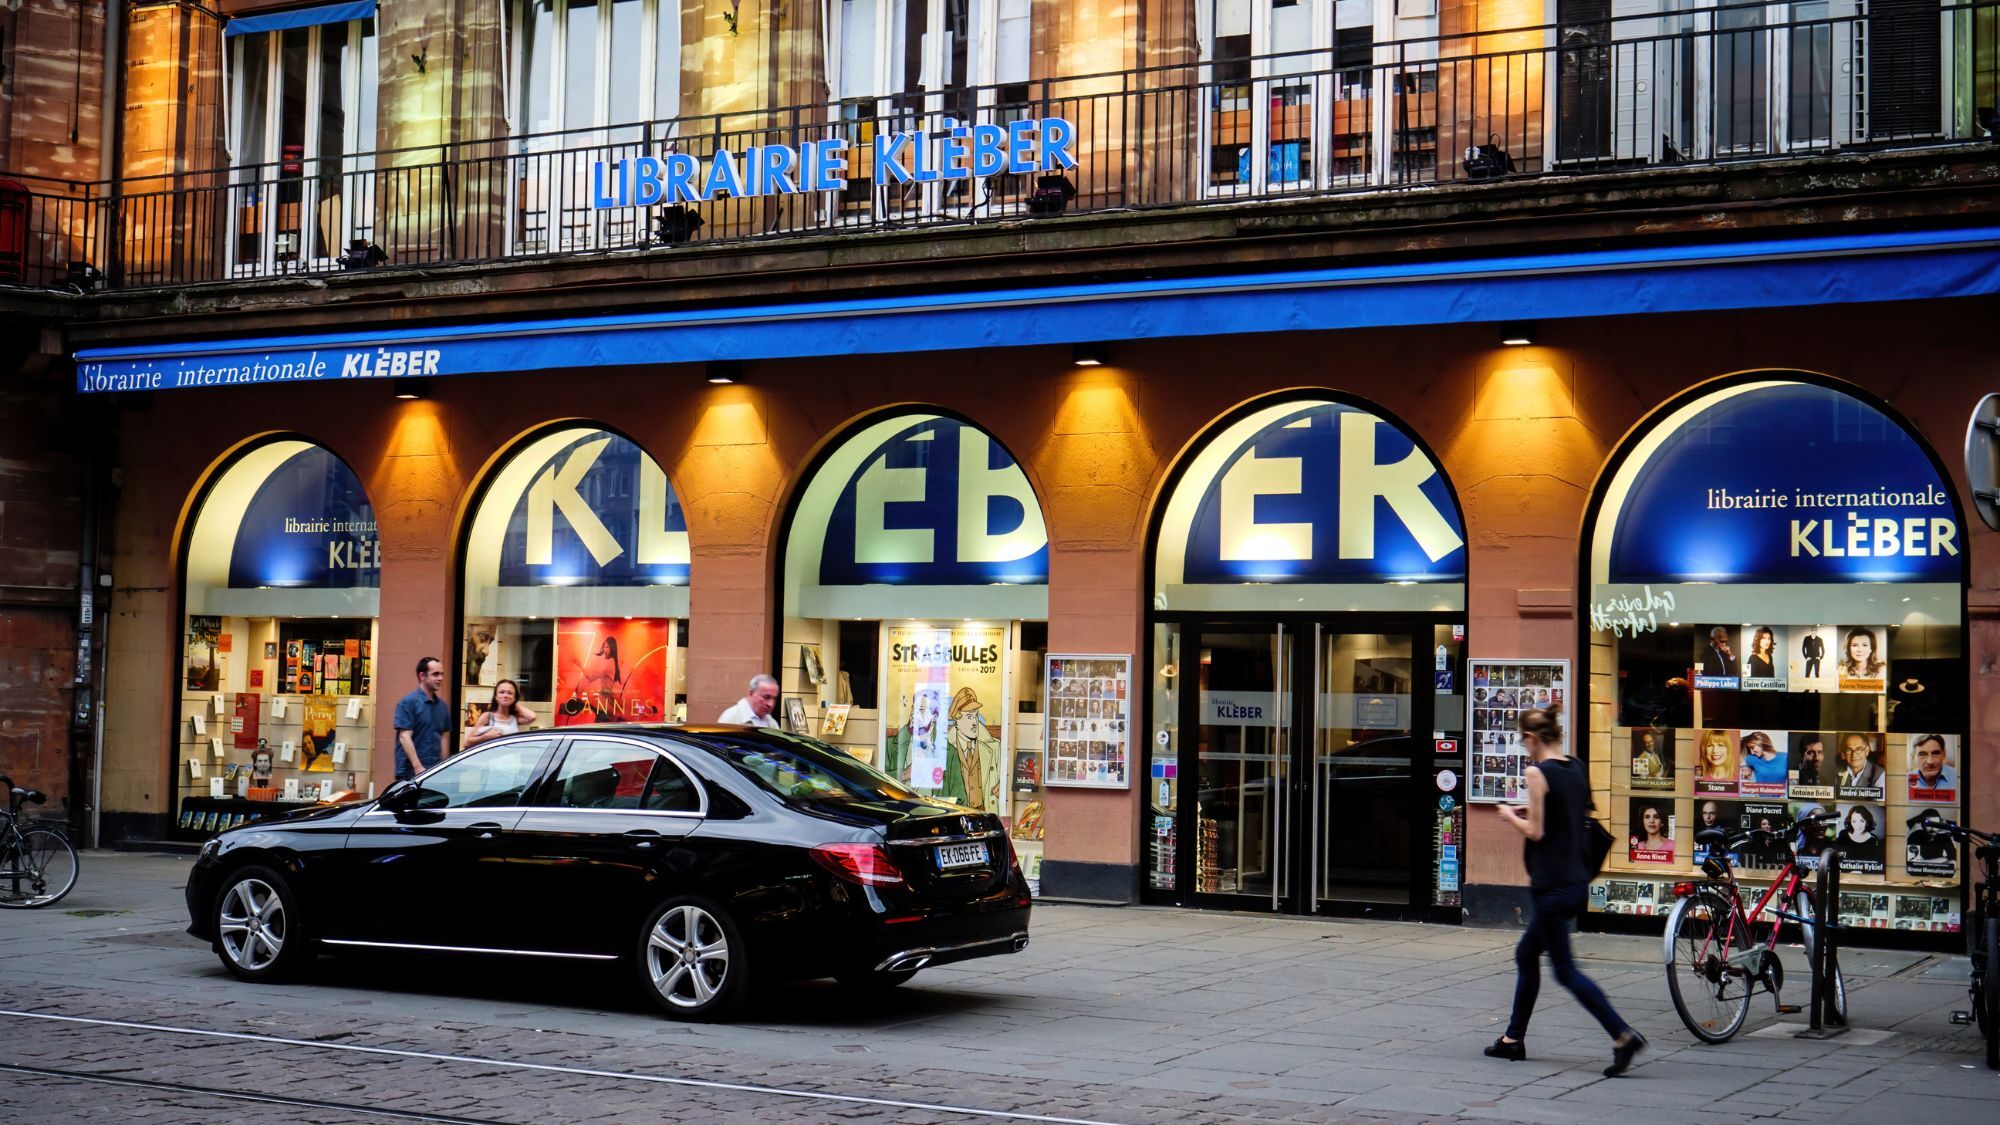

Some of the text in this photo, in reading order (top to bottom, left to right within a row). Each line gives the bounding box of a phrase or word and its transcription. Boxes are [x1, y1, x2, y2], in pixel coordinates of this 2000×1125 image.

[594, 138, 849, 209] LIBRAIRIE
[84, 363, 162, 391] librairie
[176, 352, 326, 387] internationale
[1707, 484, 1945, 509] librairie internationale
[285, 518, 329, 533] librairie
[980, 666, 996, 674] 2017
[1696, 679, 1737, 688] Philippe Labro
[565, 697, 654, 717] CANNES
[1708, 784, 1725, 792] Stone
[1840, 788, 1857, 796] André
[1858, 789, 1881, 797] Juillard
[1815, 789, 1831, 797] Bello
[1745, 806, 1782, 815] Diane Ducret
[1636, 852, 1667, 861] Anne Nivat
[1864, 862, 1883, 871] Rykiel
